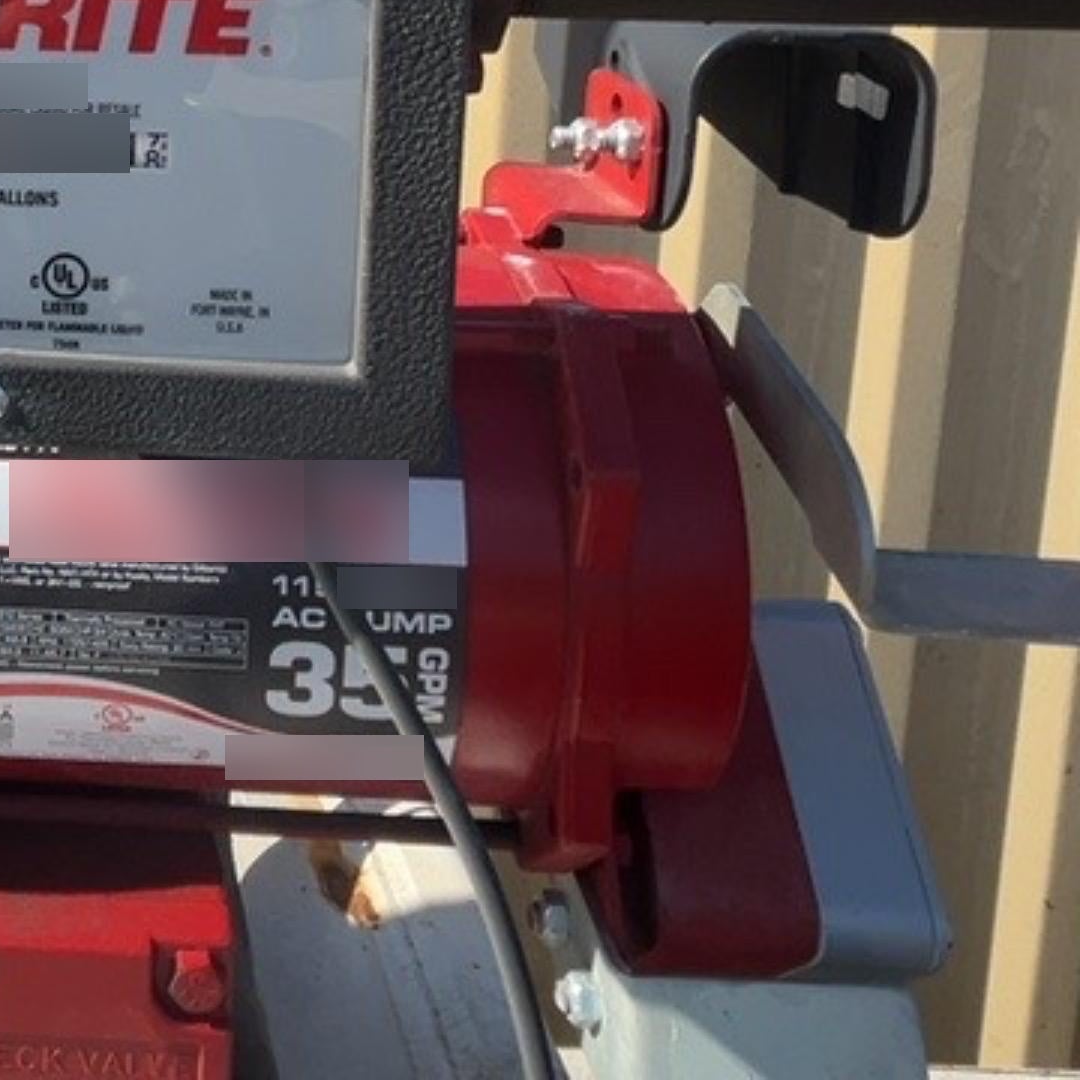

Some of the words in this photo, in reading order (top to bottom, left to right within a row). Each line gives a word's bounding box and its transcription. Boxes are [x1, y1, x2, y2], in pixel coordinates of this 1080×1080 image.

[272, 606, 327, 630] AC
[365, 610, 454, 634] UMP
[266, 641, 409, 720] 35
[416, 647, 451, 724] GPM
